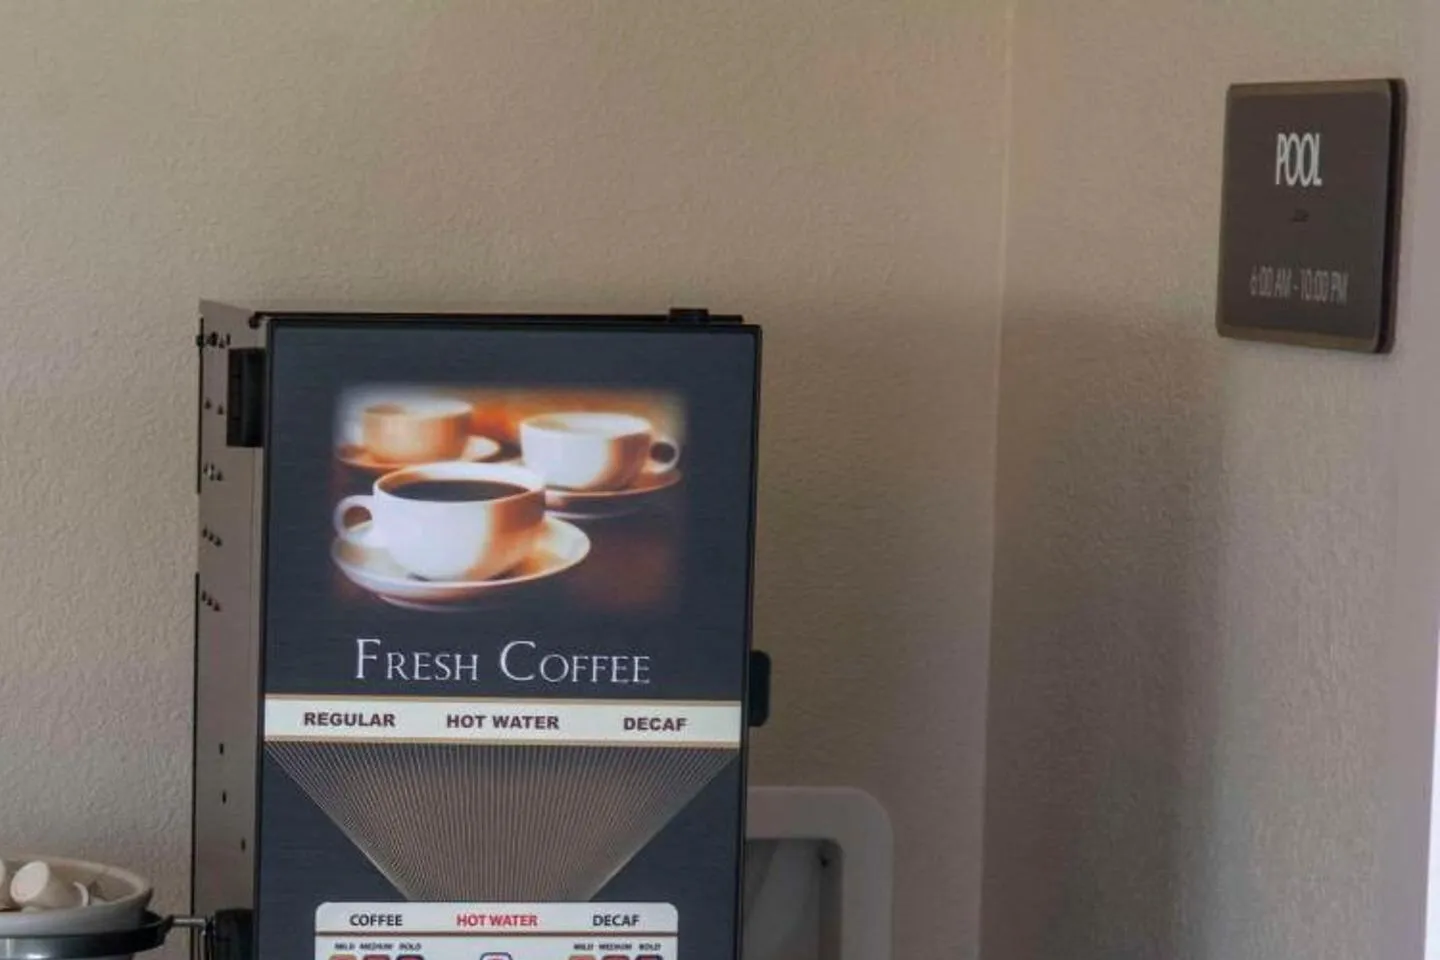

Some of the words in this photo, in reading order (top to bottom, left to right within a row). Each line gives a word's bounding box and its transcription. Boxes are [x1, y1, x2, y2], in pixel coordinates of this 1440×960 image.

[1275, 132, 1323, 187] POOL
[304, 711, 397, 728] REGULAR
[446, 714, 486, 730] HOT
[492, 714, 560, 731] WATER
[623, 717, 688, 732] DECAF
[349, 913, 404, 927] COFFEE
[456, 914, 487, 926] HOT
[489, 914, 538, 926] WATER
[592, 914, 641, 927] DECAF
